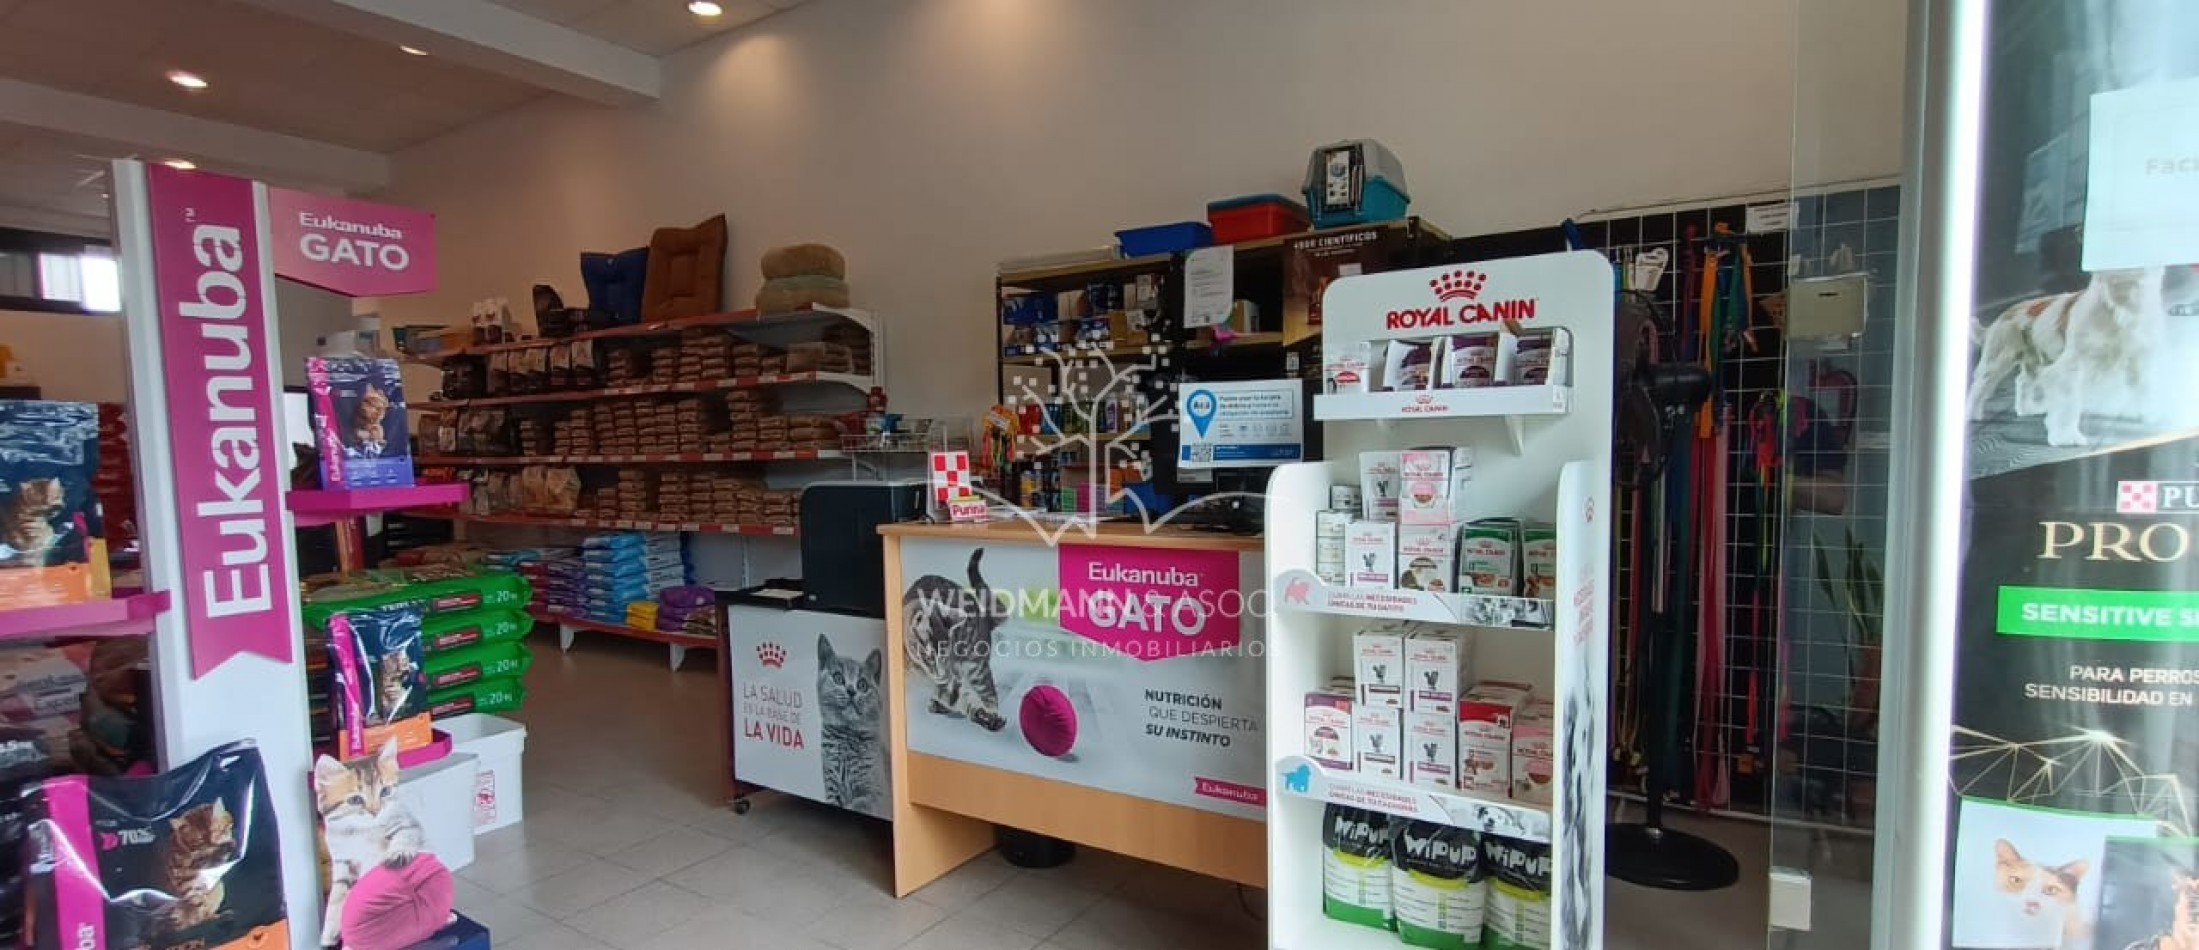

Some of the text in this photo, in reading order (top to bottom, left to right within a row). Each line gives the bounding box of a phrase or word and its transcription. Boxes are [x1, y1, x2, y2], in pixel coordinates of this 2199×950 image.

[298, 211, 402, 239] Eukanuba
[300, 232, 410, 270] GATO
[1387, 298, 1536, 329] ROYAL CANIN
[179, 224, 272, 618] Eukanuba
[952, 504, 986, 516] Purina
[2036, 521, 2190, 562] PRO
[1088, 561, 1199, 587] Eukanuba
[1087, 590, 1207, 636] GATO
[2021, 602, 2172, 627] SENSITIVE
[2070, 665, 2199, 685] PARA PERROS
[743, 681, 803, 709] LA SALUD
[1145, 689, 1223, 711] NUTRICIÓN
[2024, 683, 2193, 707] SENSIBILIDAD EN
[1149, 705, 1259, 732] QUE DESPIERTA
[744, 717, 805, 750] LA VIDA
[1146, 723, 1231, 748] SU INSTINTO
[1201, 781, 1259, 801] Eukanuba
